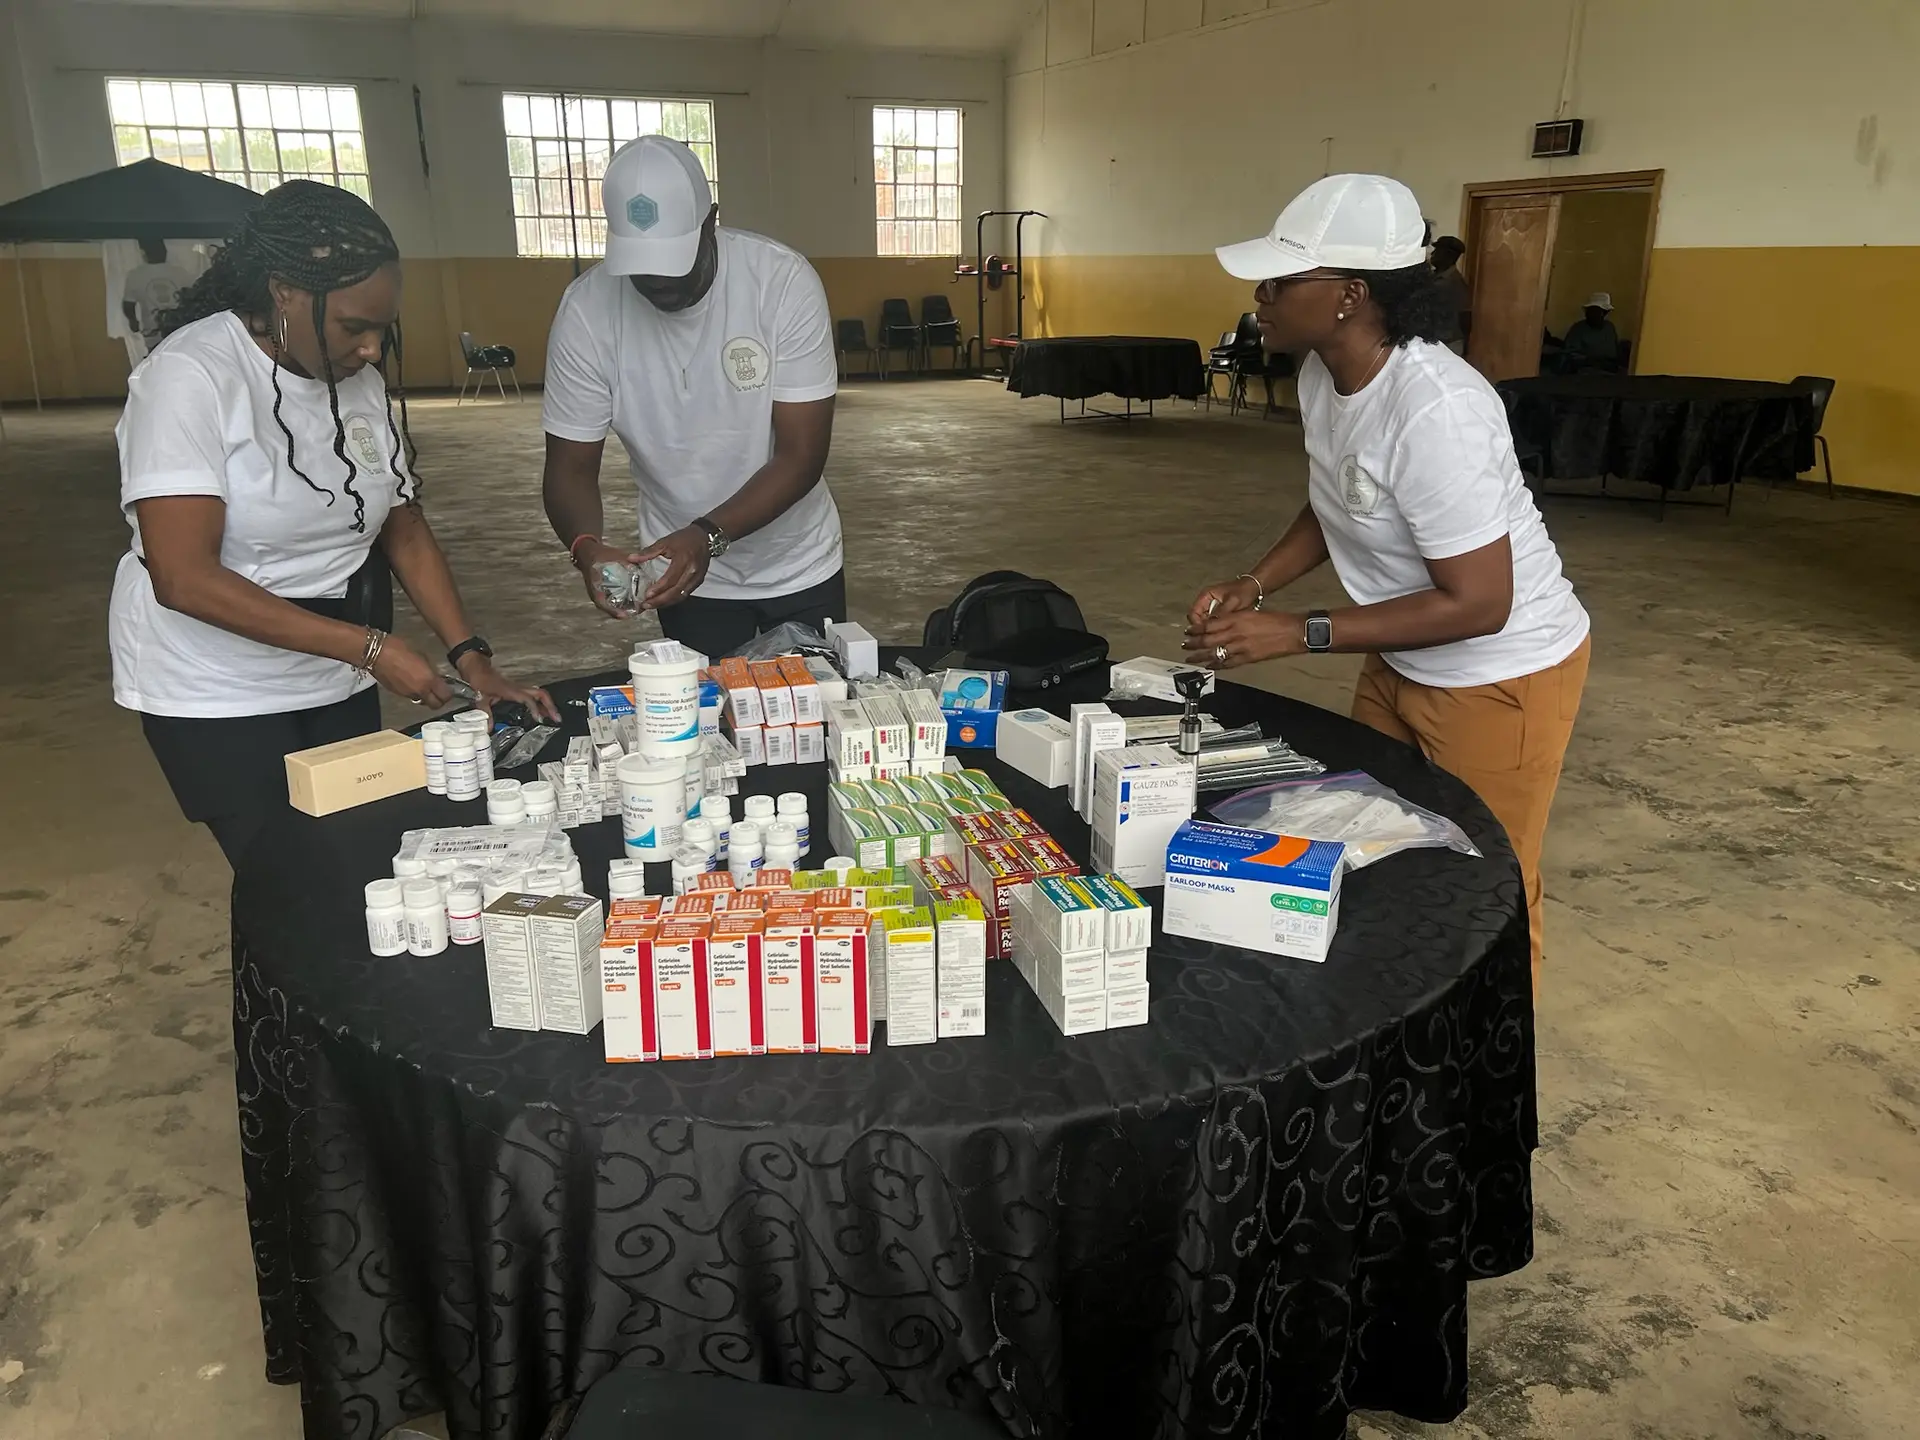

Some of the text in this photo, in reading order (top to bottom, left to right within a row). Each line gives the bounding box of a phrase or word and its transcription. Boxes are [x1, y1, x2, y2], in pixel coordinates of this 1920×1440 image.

[1285, 239, 1306, 251] MISSION
[1133, 779, 1179, 790] GAUZE PADS
[1190, 824, 1264, 840] CRITERION
[1169, 852, 1229, 872] CRITERION
[1169, 875, 1235, 894] EARLOOP MASKS
